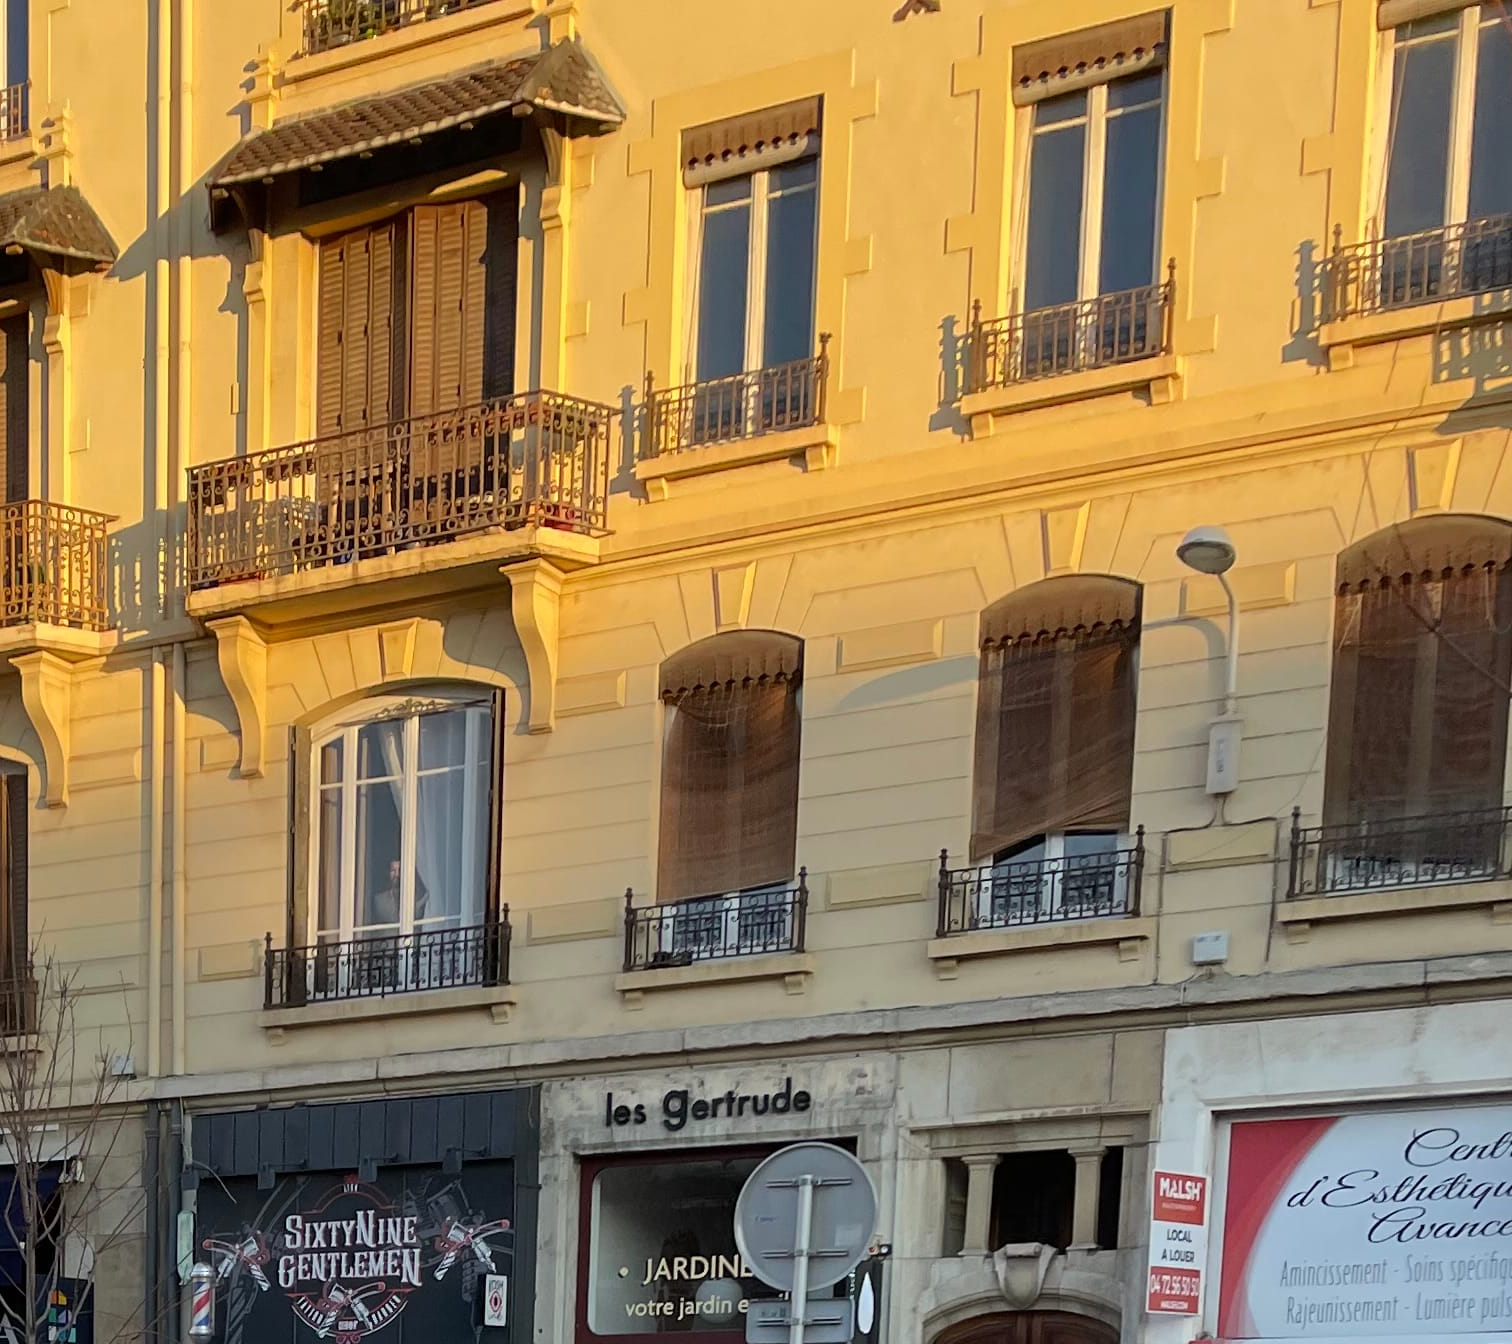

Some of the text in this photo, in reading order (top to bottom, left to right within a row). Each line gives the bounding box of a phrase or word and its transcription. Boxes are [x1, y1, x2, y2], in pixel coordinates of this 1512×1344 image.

[605, 1076, 812, 1131] les gertrude
[1166, 1228, 1193, 1243] LOCAL
[277, 1248, 423, 1288] GENTLEMEN
[1170, 1249, 1195, 1263] LOUER
[1280, 1257, 1388, 1288] Amincissement
[1403, 1253, 1444, 1284] Soins
[625, 1298, 674, 1317] votre
[677, 1293, 732, 1321] jardin
[1286, 1295, 1398, 1329] Rajeunissement
[1415, 1291, 1475, 1321] Lumière
